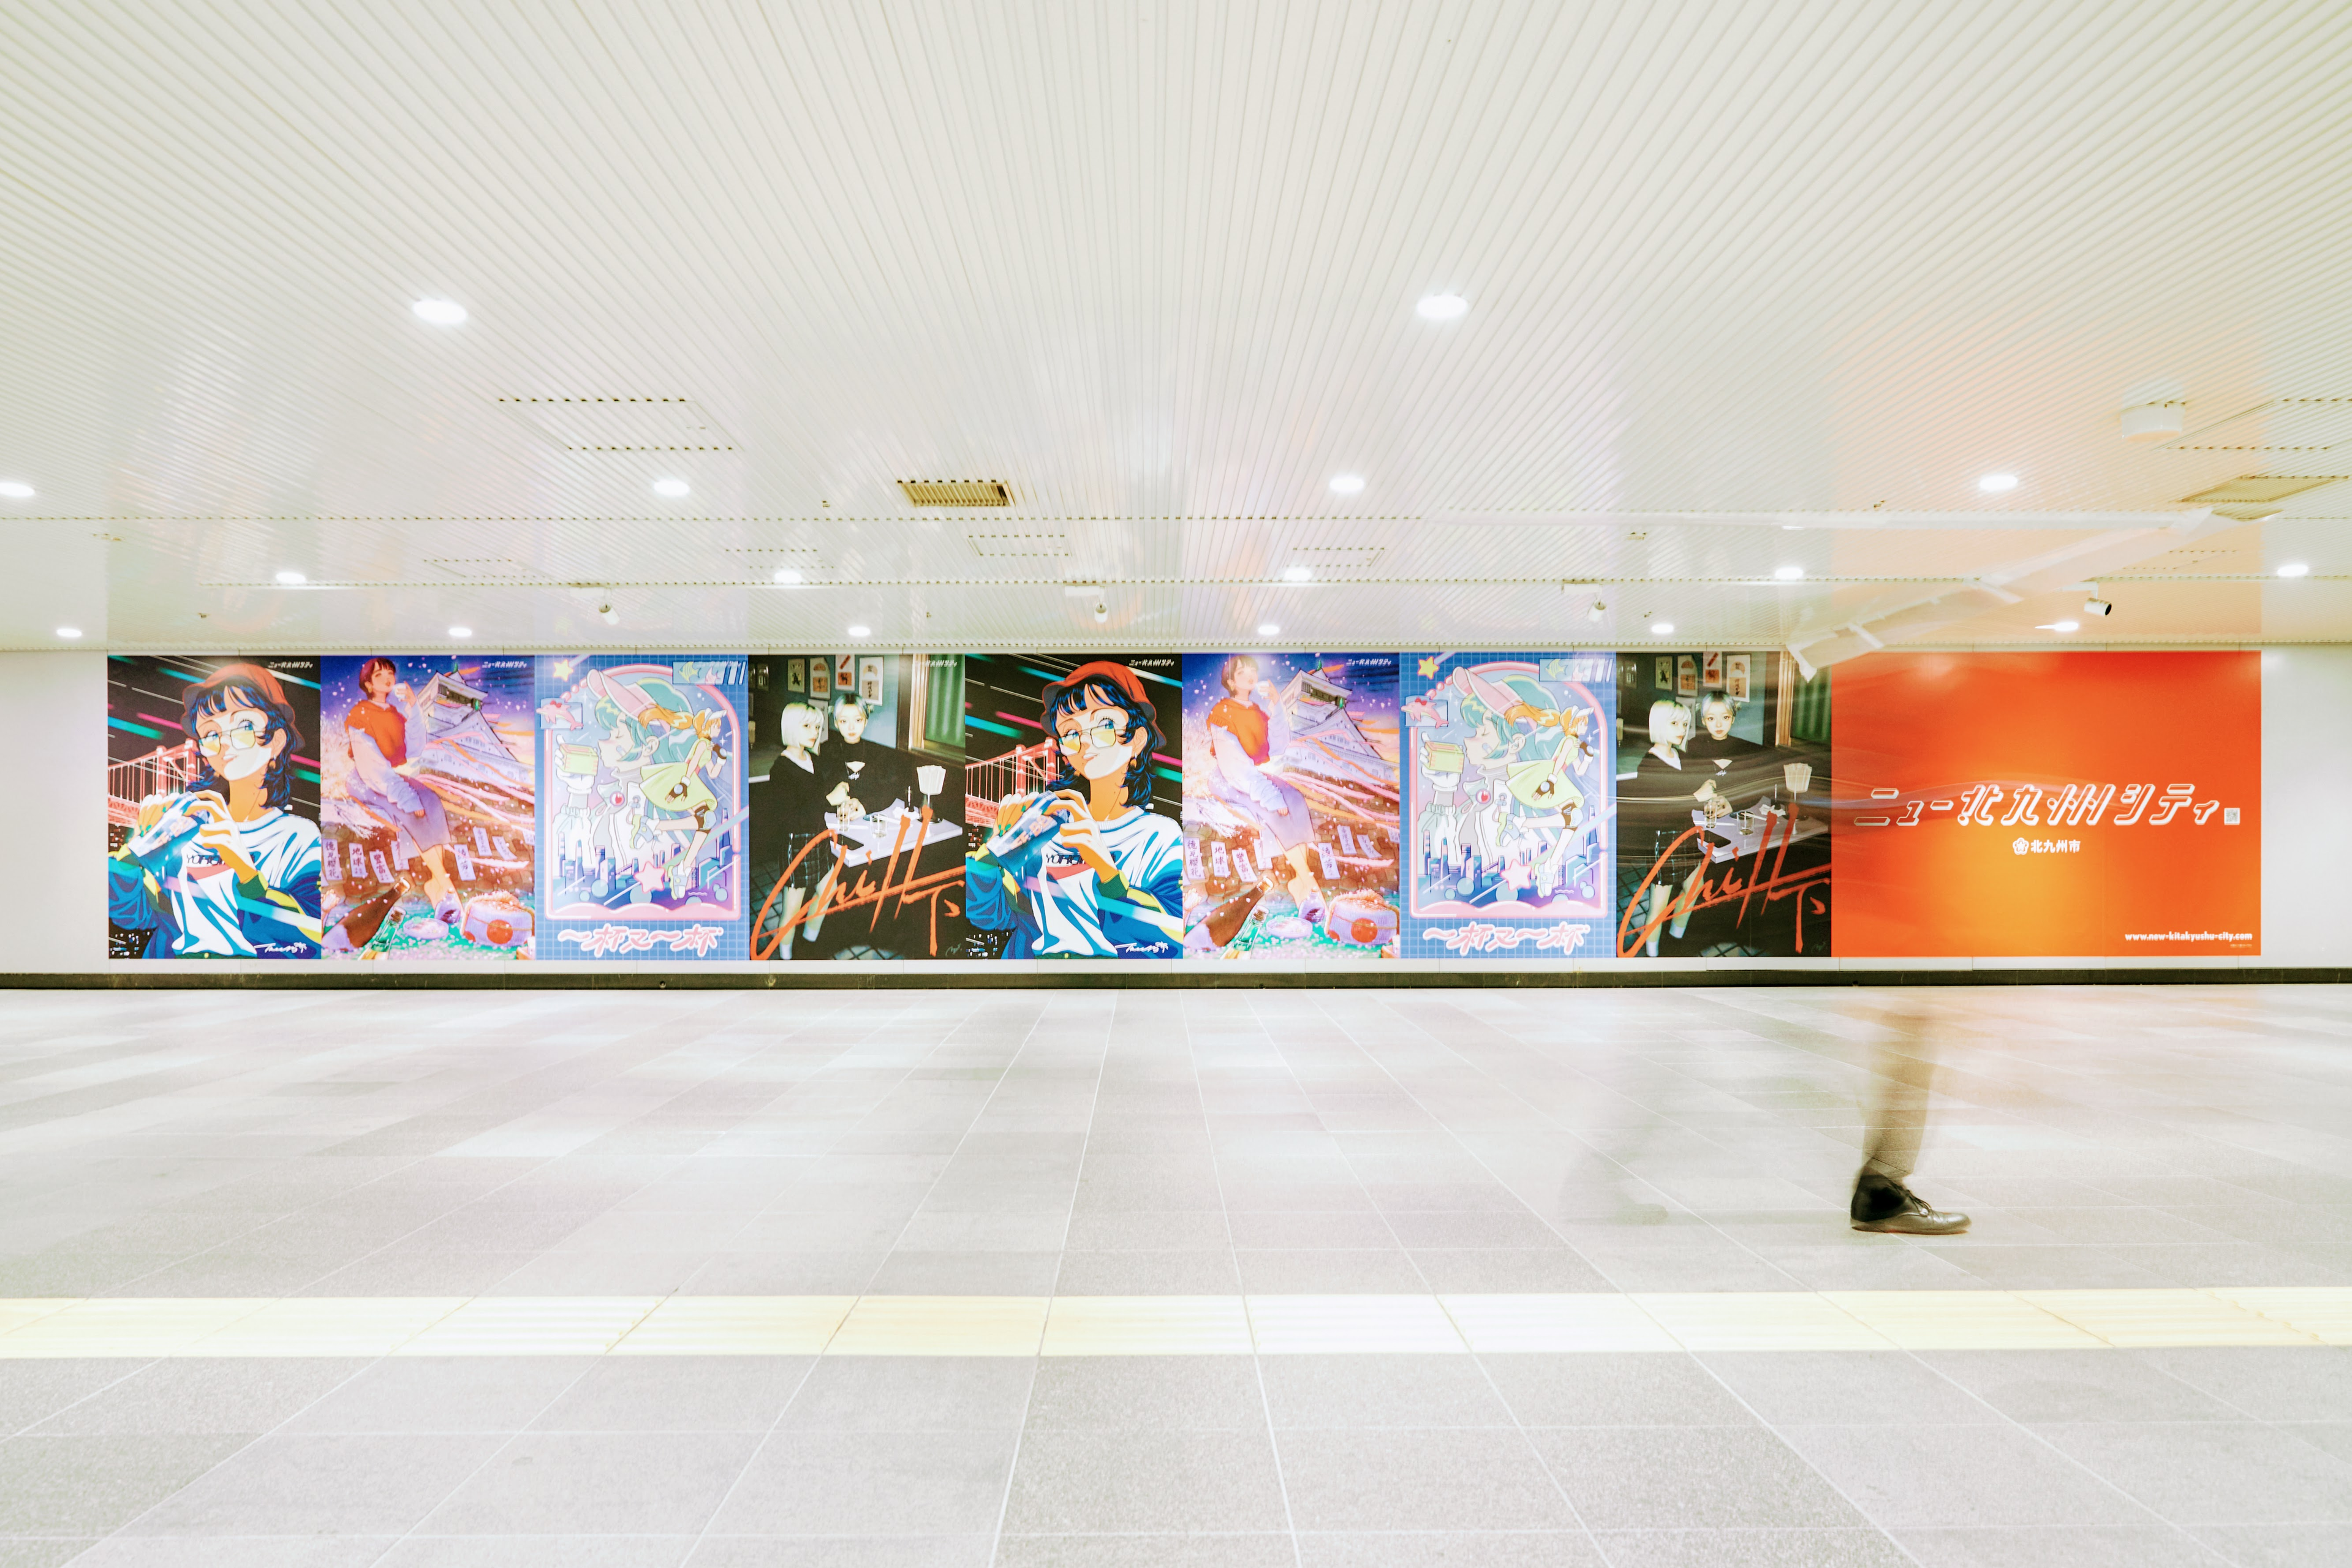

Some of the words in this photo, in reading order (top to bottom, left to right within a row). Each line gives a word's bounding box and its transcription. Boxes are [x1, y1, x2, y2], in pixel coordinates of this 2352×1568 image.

[1853, 783, 2220, 826] ニュー北九州シティ
[2030, 839, 2081, 853] 北九州市
[2125, 931, 2252, 942] www.new-kitakyushu-city.com
